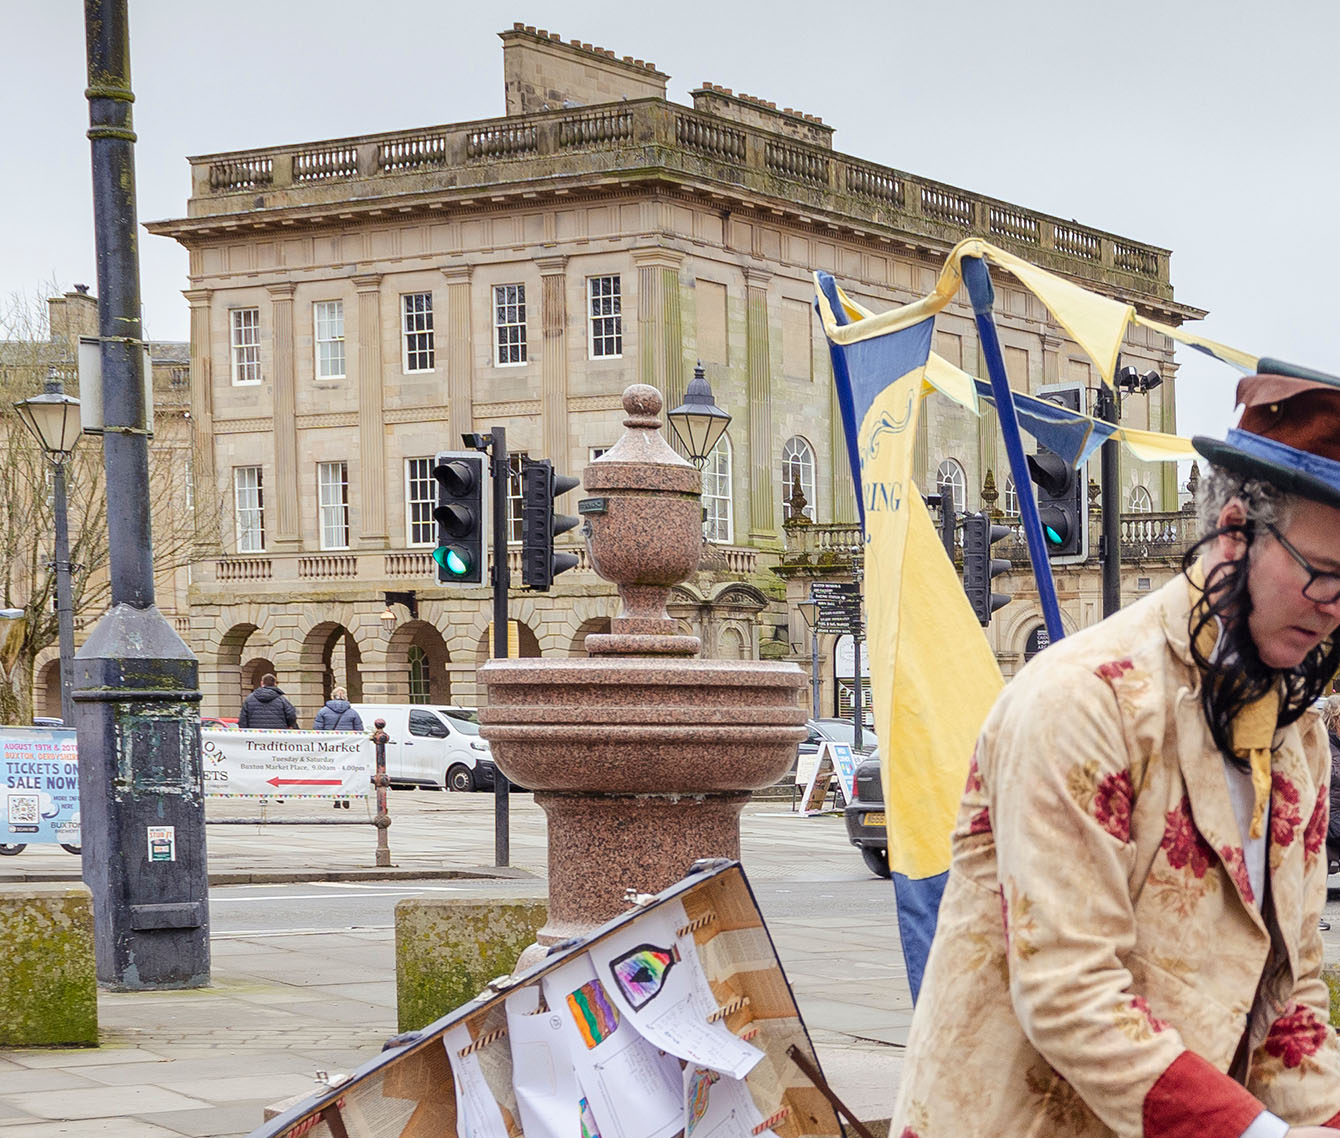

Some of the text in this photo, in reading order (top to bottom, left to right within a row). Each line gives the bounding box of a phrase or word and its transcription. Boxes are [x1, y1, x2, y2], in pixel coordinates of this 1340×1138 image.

[4, 743, 32, 751] AUGUST
[245, 741, 361, 753] Traditional Market
[6, 762, 60, 775] TICKETS
[7, 776, 41, 789] SALE
